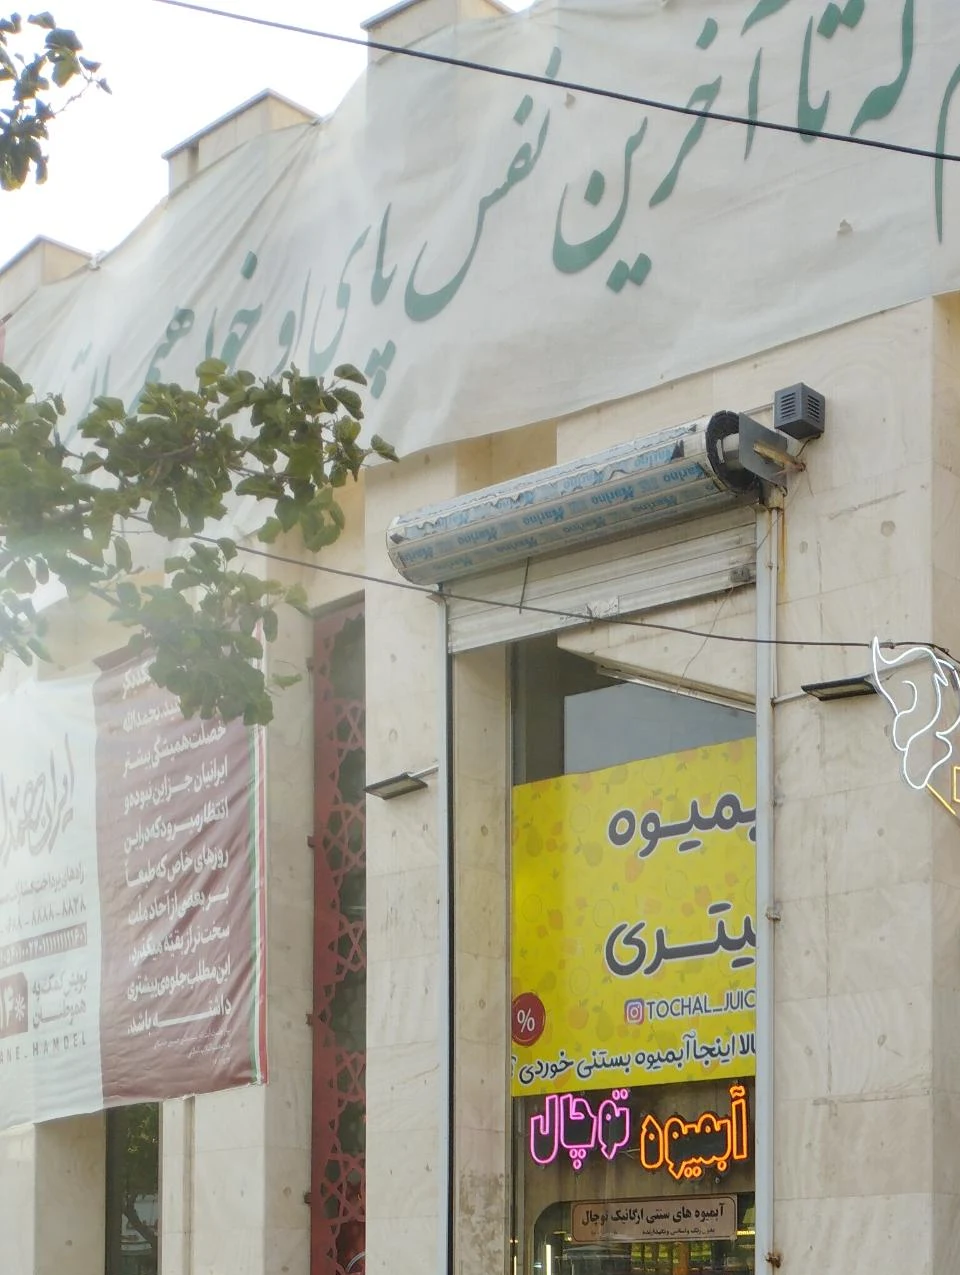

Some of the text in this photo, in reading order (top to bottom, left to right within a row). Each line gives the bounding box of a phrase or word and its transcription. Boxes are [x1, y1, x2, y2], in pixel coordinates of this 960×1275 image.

[552, 0, 792, 293] آخرین
[404, 46, 561, 323] نفس
[605, 901, 757, 976] یتری
[518, 1050, 574, 1085] خوردی
[577, 1050, 631, 1079] بستنی
[634, 1029, 696, 1071] آبمیوه
[693, 1035, 736, 1066] اینجا
[529, 1084, 749, 1180] آبمیوه توچال
[695, 1203, 725, 1223] آبمیوه
